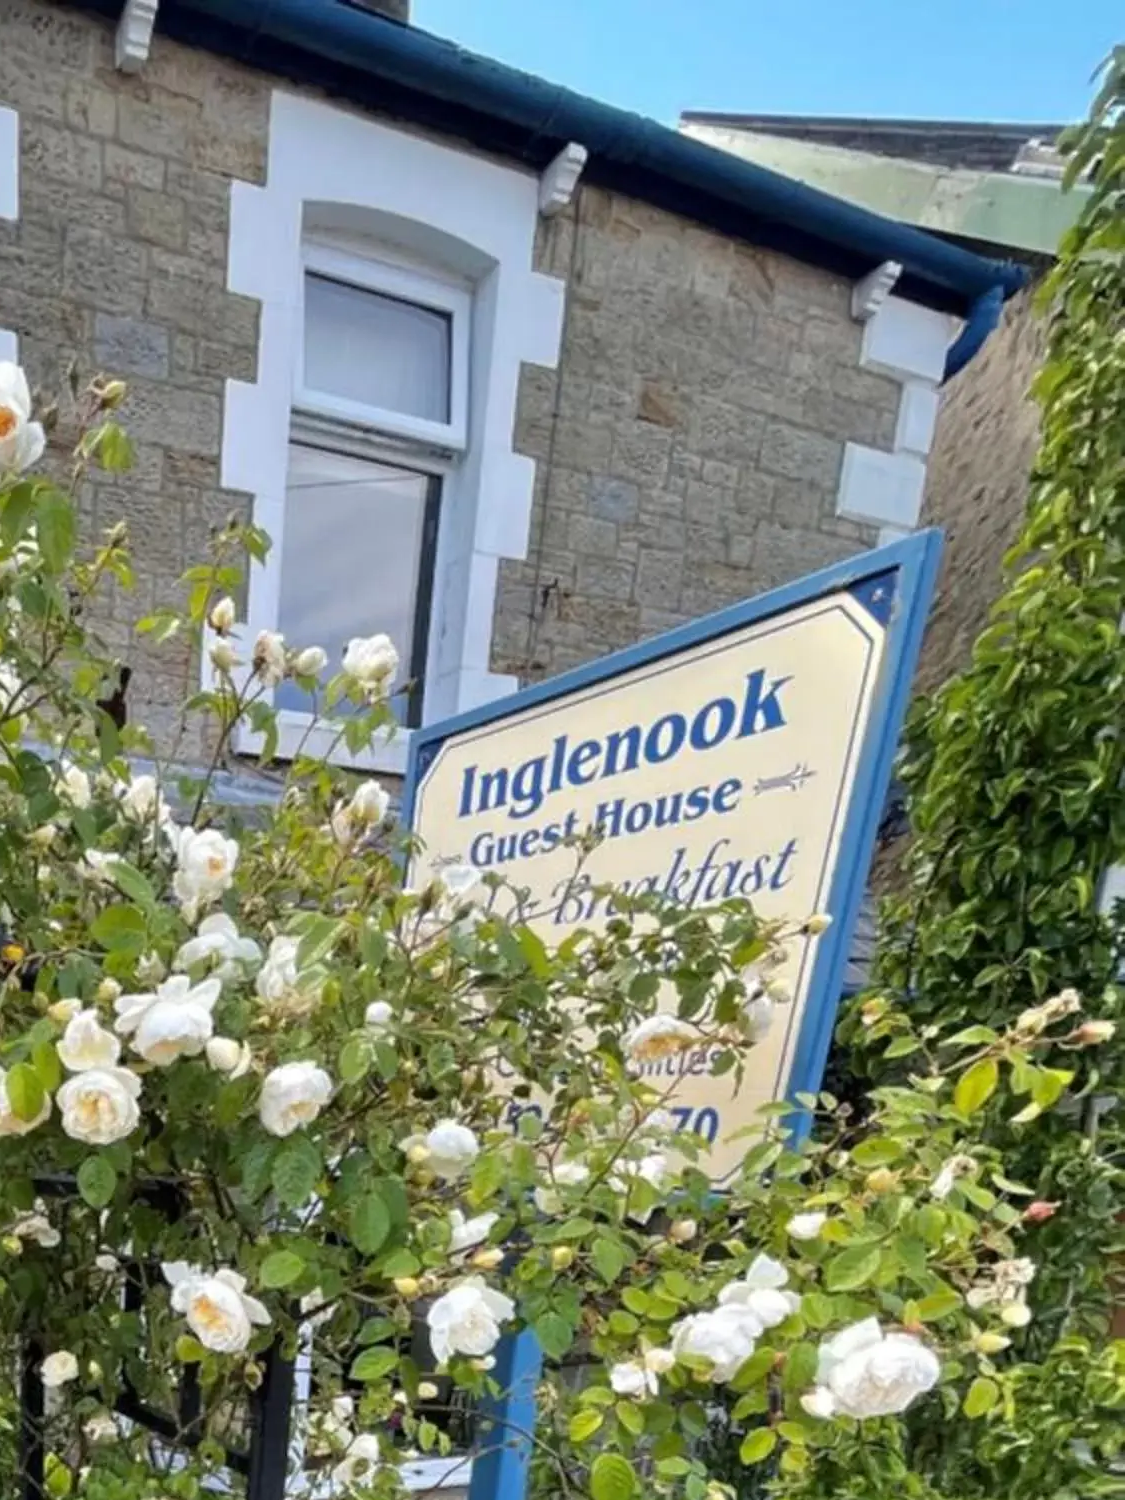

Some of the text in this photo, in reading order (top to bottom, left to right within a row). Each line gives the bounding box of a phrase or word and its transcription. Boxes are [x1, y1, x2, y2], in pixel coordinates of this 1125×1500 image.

[458, 668, 794, 819] Inglenook
[470, 778, 743, 868] Guest House
